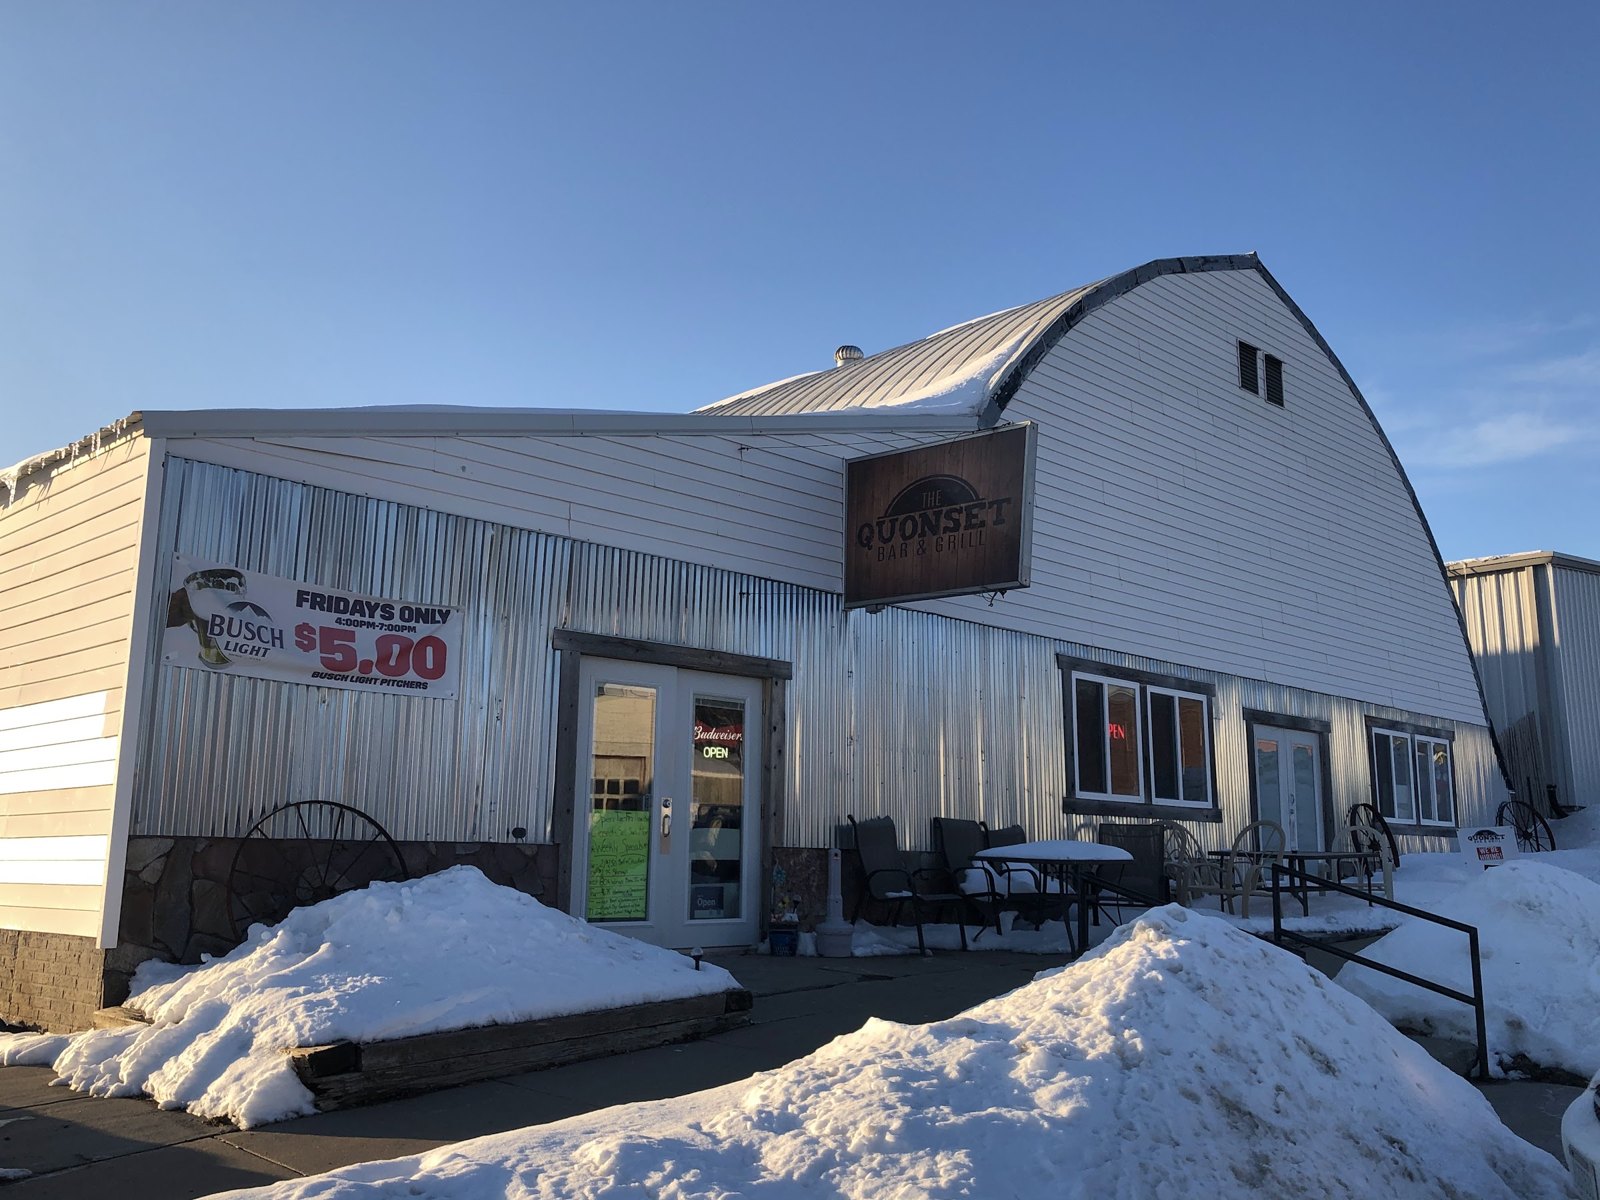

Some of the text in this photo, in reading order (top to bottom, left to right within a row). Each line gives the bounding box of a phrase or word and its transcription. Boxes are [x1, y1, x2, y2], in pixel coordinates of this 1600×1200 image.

[921, 489, 943, 507] THE
[857, 497, 1012, 551] QUONSET
[878, 530, 985, 562] BAR & GRILL
[295, 589, 450, 625] FRIDAYS ONLY
[208, 613, 285, 650] BUSCH
[335, 616, 417, 634] 4:00PM-7:00PM
[223, 640, 271, 658] LIGHT
[294, 622, 448, 681] $5.00
[311, 671, 429, 690] BUSCH LIGHT PITCHERS
[694, 725, 743, 741] Budweiser
[1108, 723, 1126, 740] PEN
[703, 746, 729, 759] OPEN
